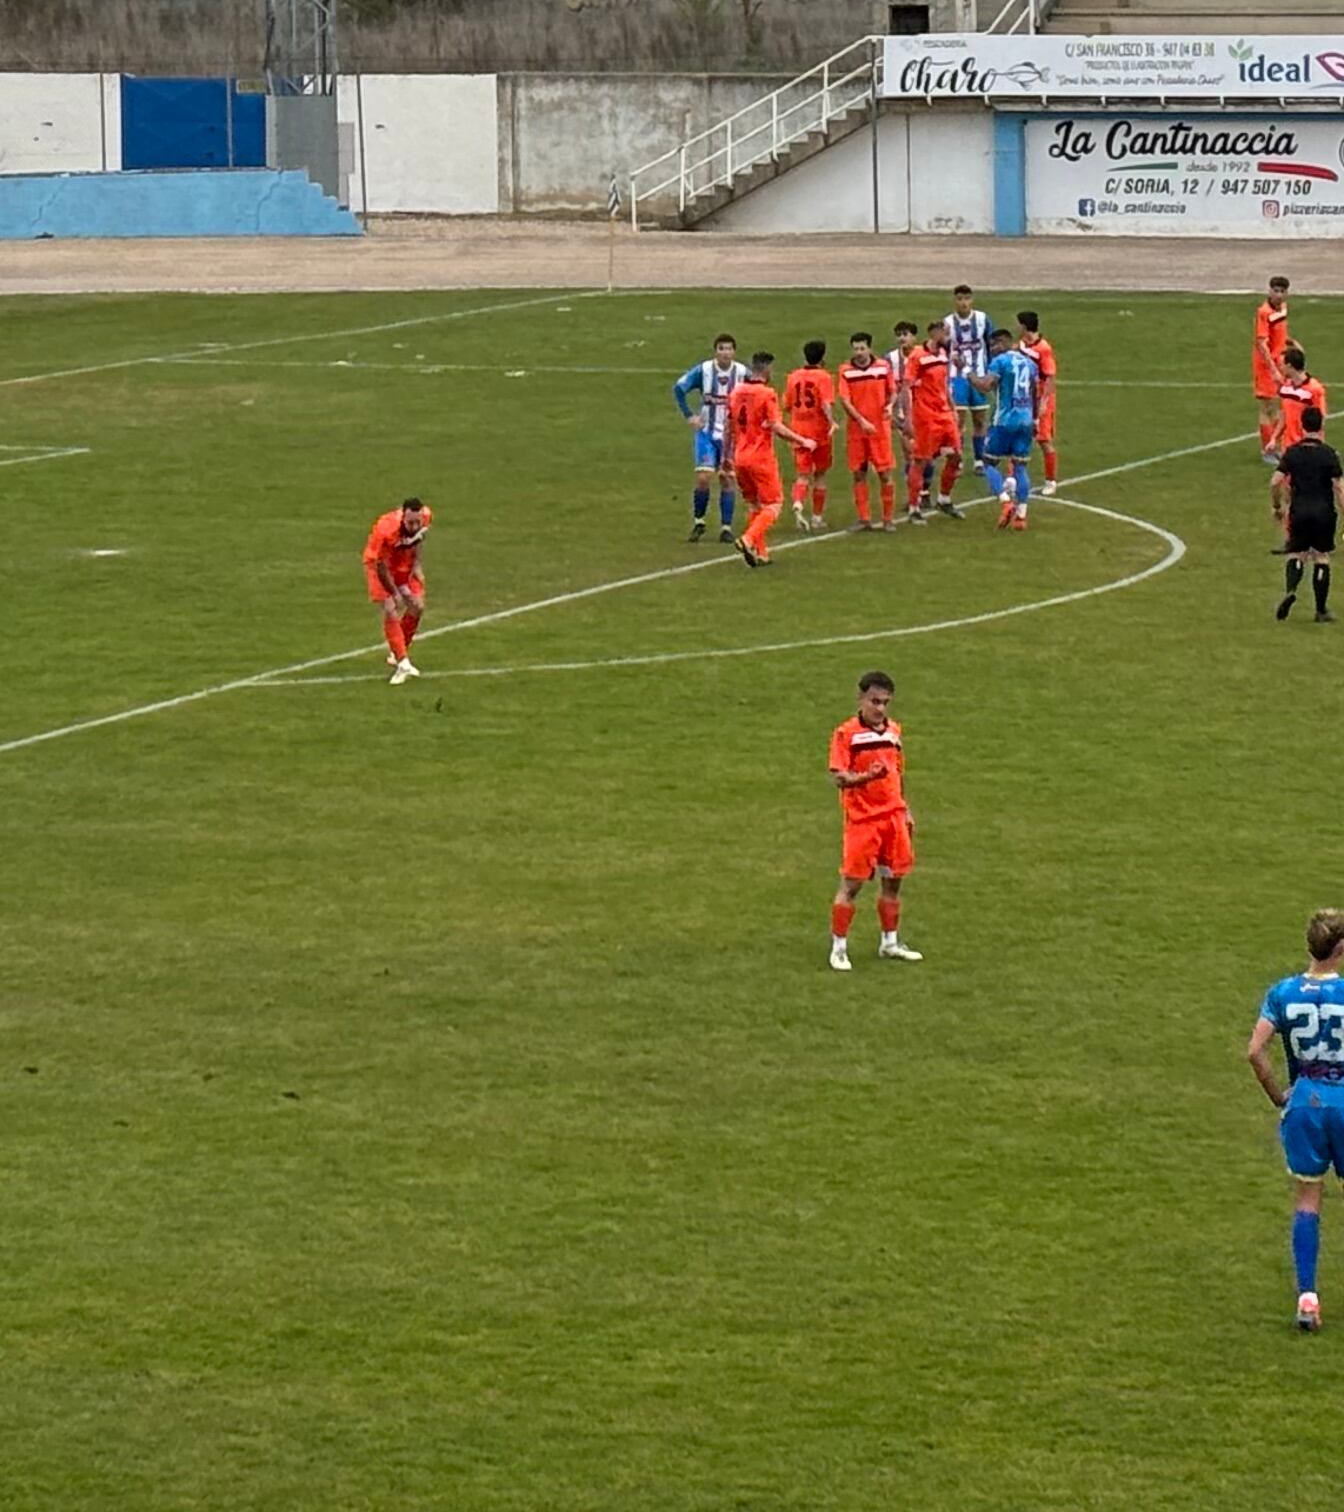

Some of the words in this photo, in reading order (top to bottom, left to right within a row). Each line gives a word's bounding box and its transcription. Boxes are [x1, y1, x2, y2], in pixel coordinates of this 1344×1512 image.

[1076, 43, 1094, 57] SAN
[1096, 42, 1143, 57] FRANCISCO
[900, 56, 997, 94] Charo
[1239, 54, 1310, 83] ideal
[1049, 119, 1097, 162] La
[1106, 120, 1299, 160] Cantinaccia
[1222, 161, 1251, 173] 1992
[1123, 178, 1175, 196] SORIA,
[1181, 178, 1199, 194] 12
[1220, 178, 1248, 195] 947
[1251, 179, 1282, 195] 507
[1285, 180, 1312, 196] 150
[1013, 358, 1031, 397] 14
